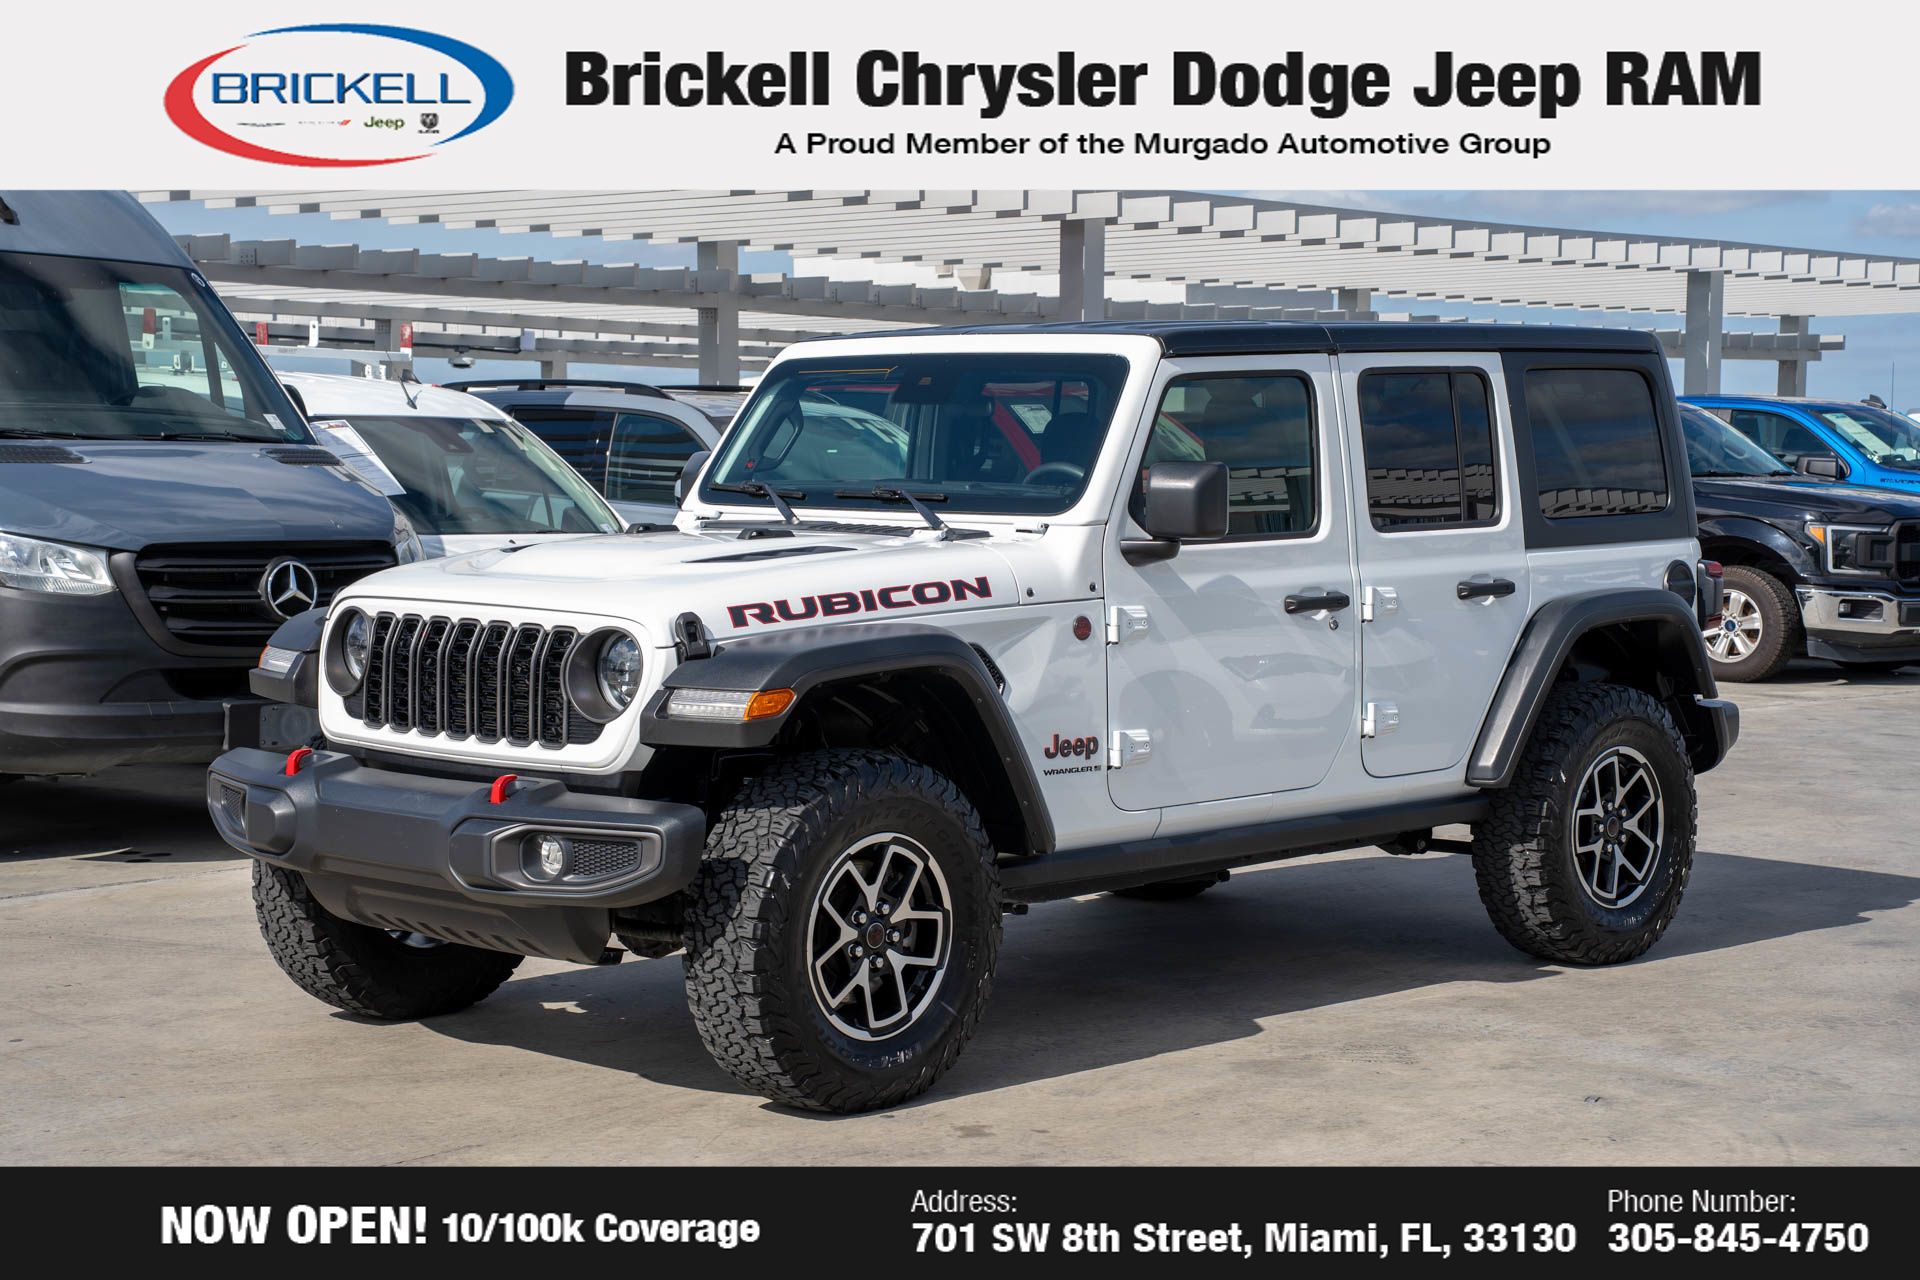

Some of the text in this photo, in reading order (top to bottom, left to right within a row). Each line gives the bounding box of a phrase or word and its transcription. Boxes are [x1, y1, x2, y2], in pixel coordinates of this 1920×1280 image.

[727, 576, 992, 629] RUBICON
[1044, 734, 1099, 760] Jeep
[1043, 765, 1093, 776] WRANGLER
